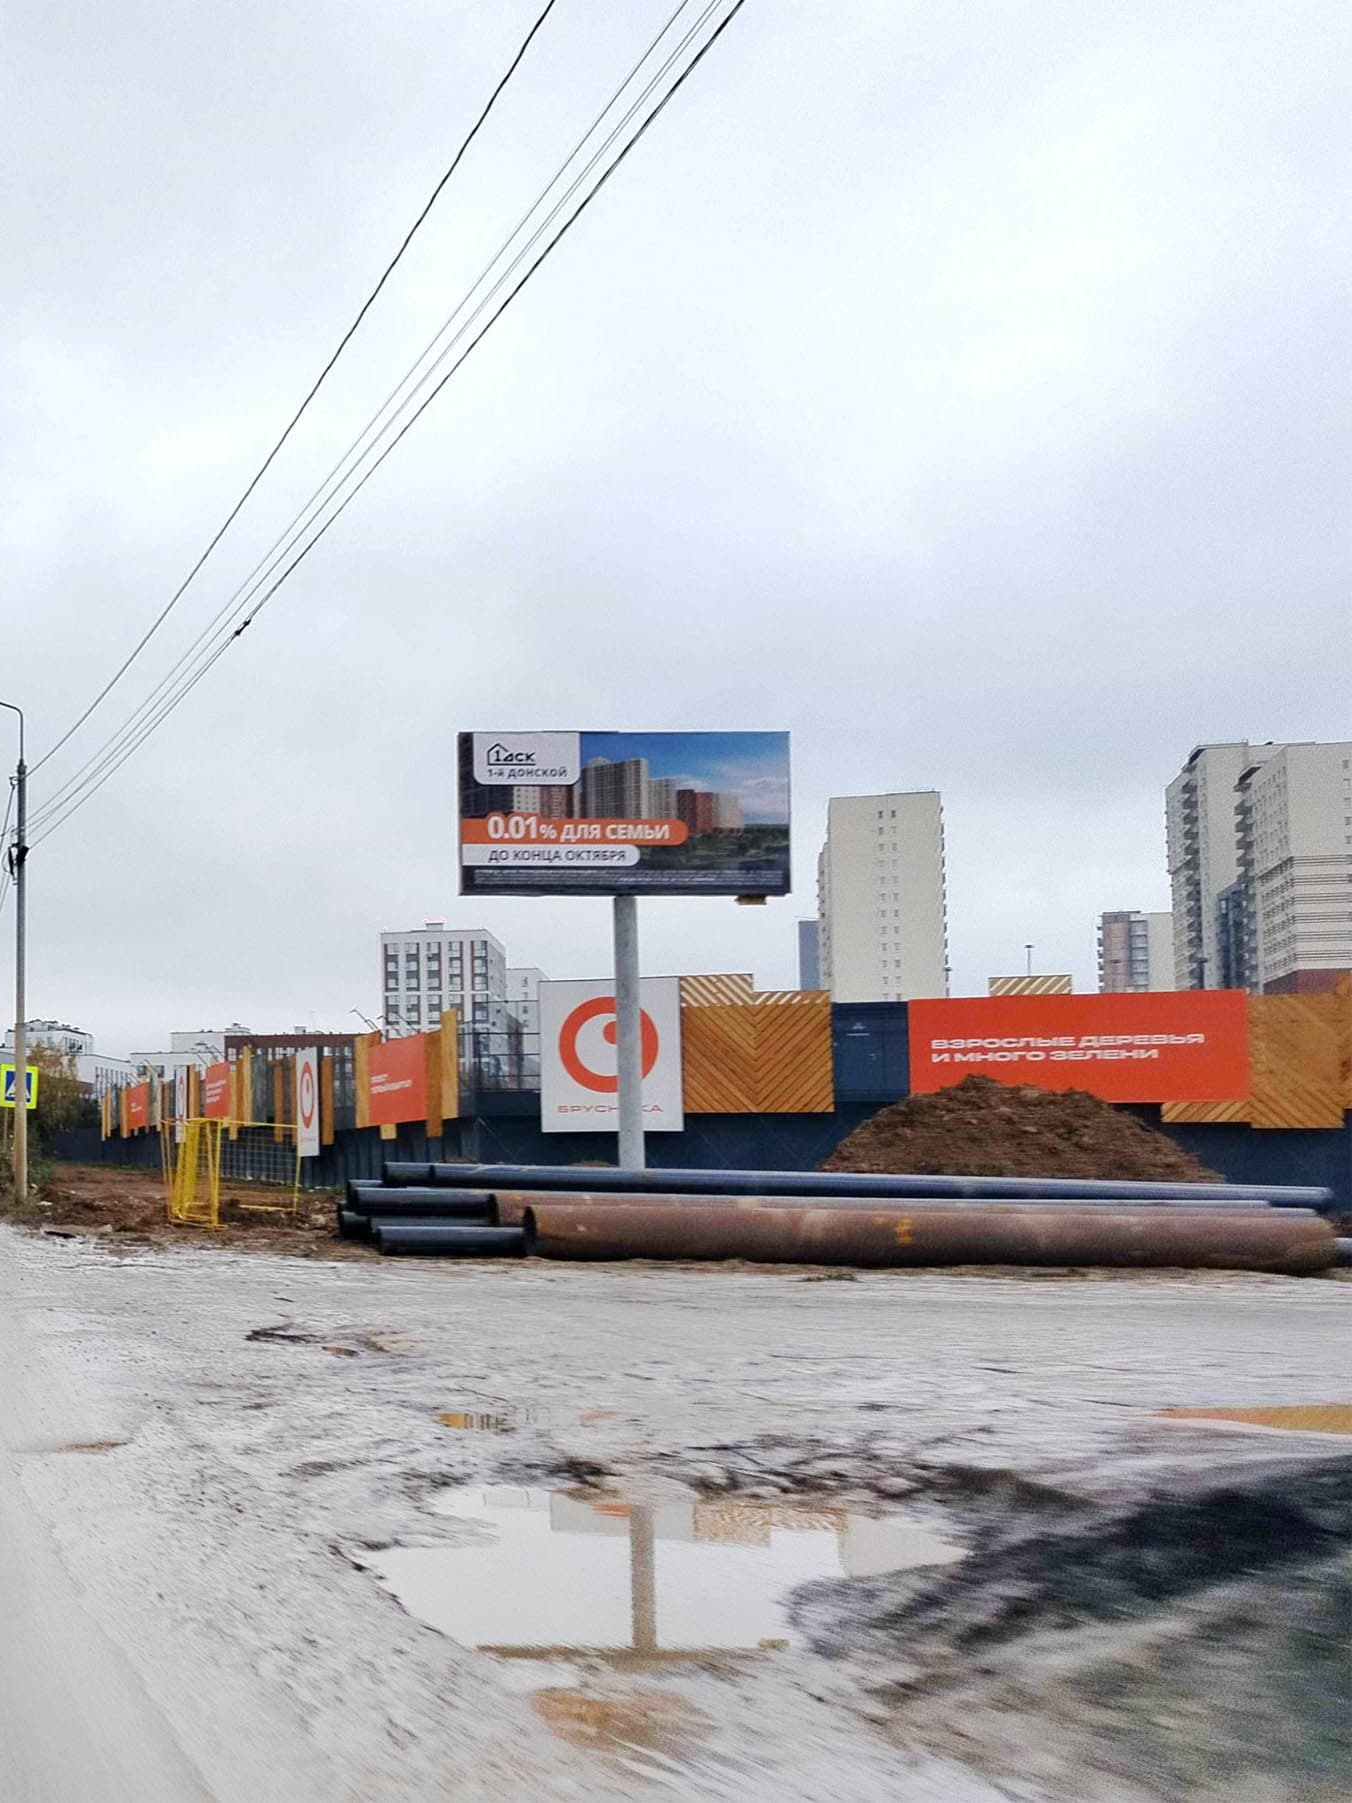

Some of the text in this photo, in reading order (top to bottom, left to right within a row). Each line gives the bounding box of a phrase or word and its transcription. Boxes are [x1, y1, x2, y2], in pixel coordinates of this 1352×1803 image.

[508, 766, 568, 779] ДОНСКОЙ
[559, 824, 601, 842] ДЛЯ
[605, 824, 670, 840] СЕМЬИ
[488, 850, 627, 862] ДО КОНЦА ОКТЯБРЯ
[931, 1033, 1206, 1050] ВЗРОСЛЫЕ ДЕРЕВЬЯ
[931, 1048, 1160, 1063] И МНОГО ЗЕЛЕНИ
[557, 1104, 664, 1114] БРУСНКА
